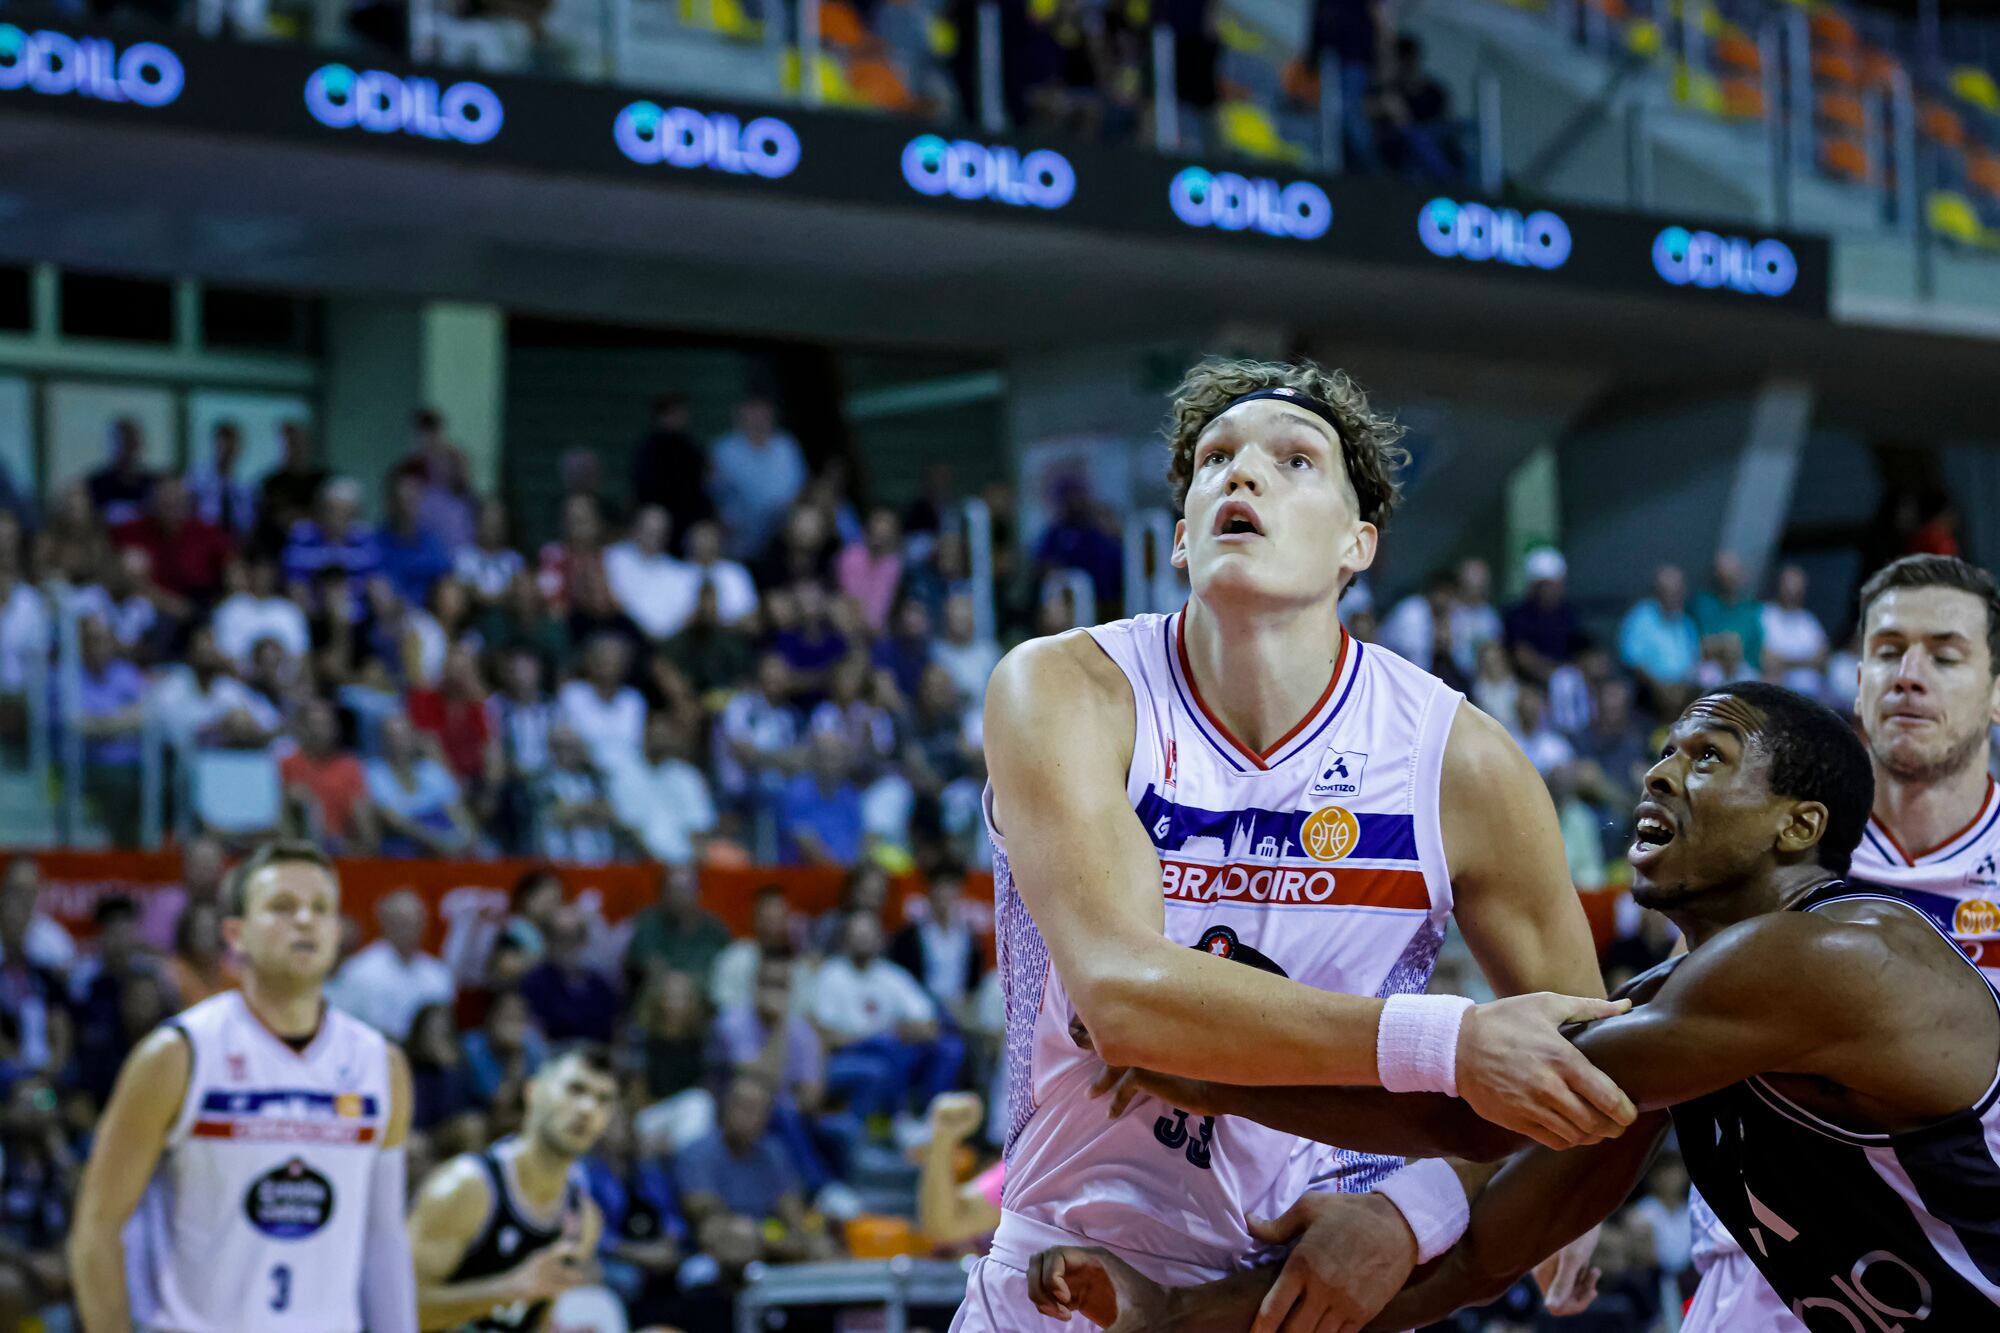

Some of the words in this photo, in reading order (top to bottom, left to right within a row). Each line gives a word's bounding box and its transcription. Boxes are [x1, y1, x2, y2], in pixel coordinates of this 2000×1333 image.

[304, 64, 504, 144] ODILO
[614, 101, 801, 178] ODILO
[901, 135, 1076, 208] ODILO
[1169, 167, 1332, 239] ODILO
[1418, 198, 1572, 269] ODILO
[1652, 227, 1797, 296] ODILO
[1314, 784, 1356, 793] CORTIZO
[270, 1263, 292, 1313] 3
